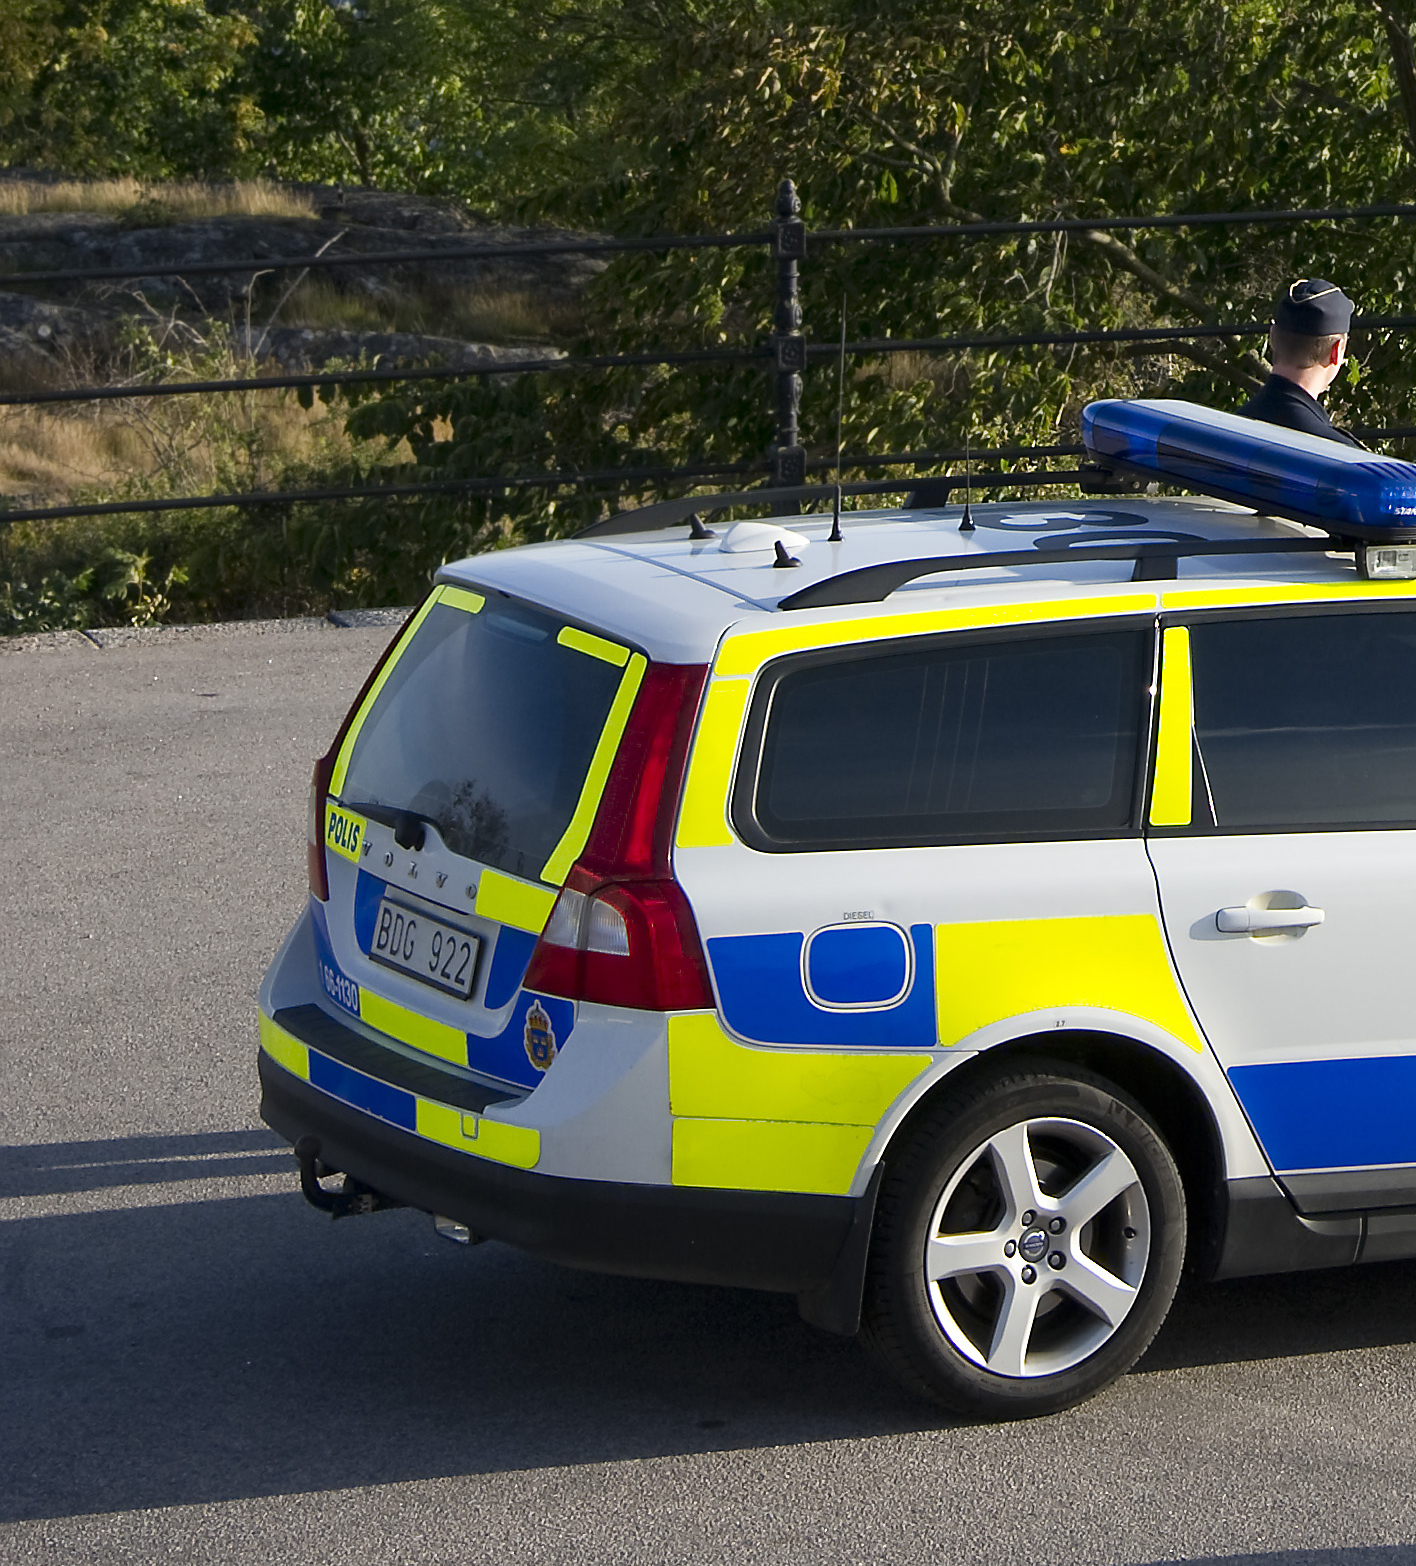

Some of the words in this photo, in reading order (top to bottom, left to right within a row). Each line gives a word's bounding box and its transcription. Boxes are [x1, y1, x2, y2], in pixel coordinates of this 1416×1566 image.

[327, 811, 361, 853] POLIS
[361, 839, 478, 900] VOLVO
[843, 910, 874, 921] DIESEL
[376, 906, 417, 961] BDG
[428, 930, 471, 986] 922
[324, 965, 359, 1012] 66-1130
